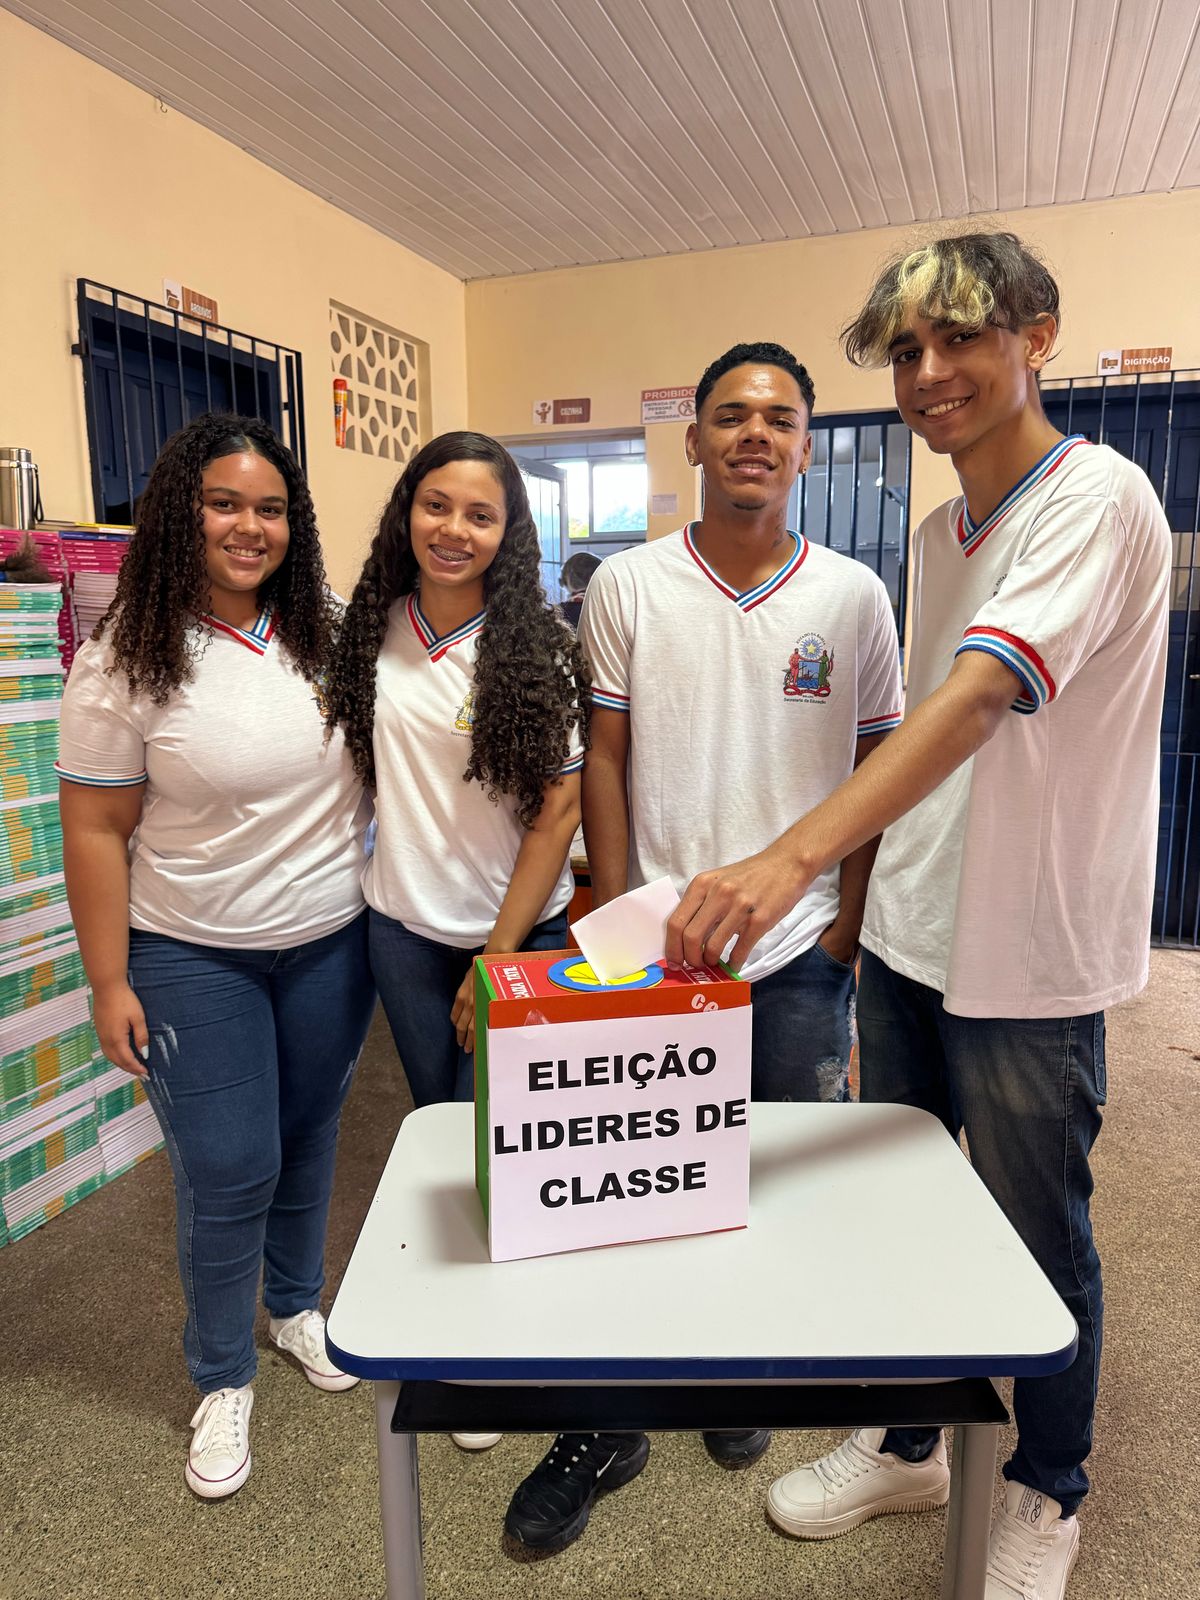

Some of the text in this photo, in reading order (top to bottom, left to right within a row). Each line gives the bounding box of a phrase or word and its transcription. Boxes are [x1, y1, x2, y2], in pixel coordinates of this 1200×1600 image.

[1124, 356, 1170, 366] DIGITAÇÃO
[644, 388, 696, 399] PROIBIDO
[560, 407, 583, 416] COZINHA
[528, 1043, 717, 1092] ELEIÇÃO
[494, 1098, 747, 1155] LIDERES DE
[539, 1161, 707, 1209] CLASSE
